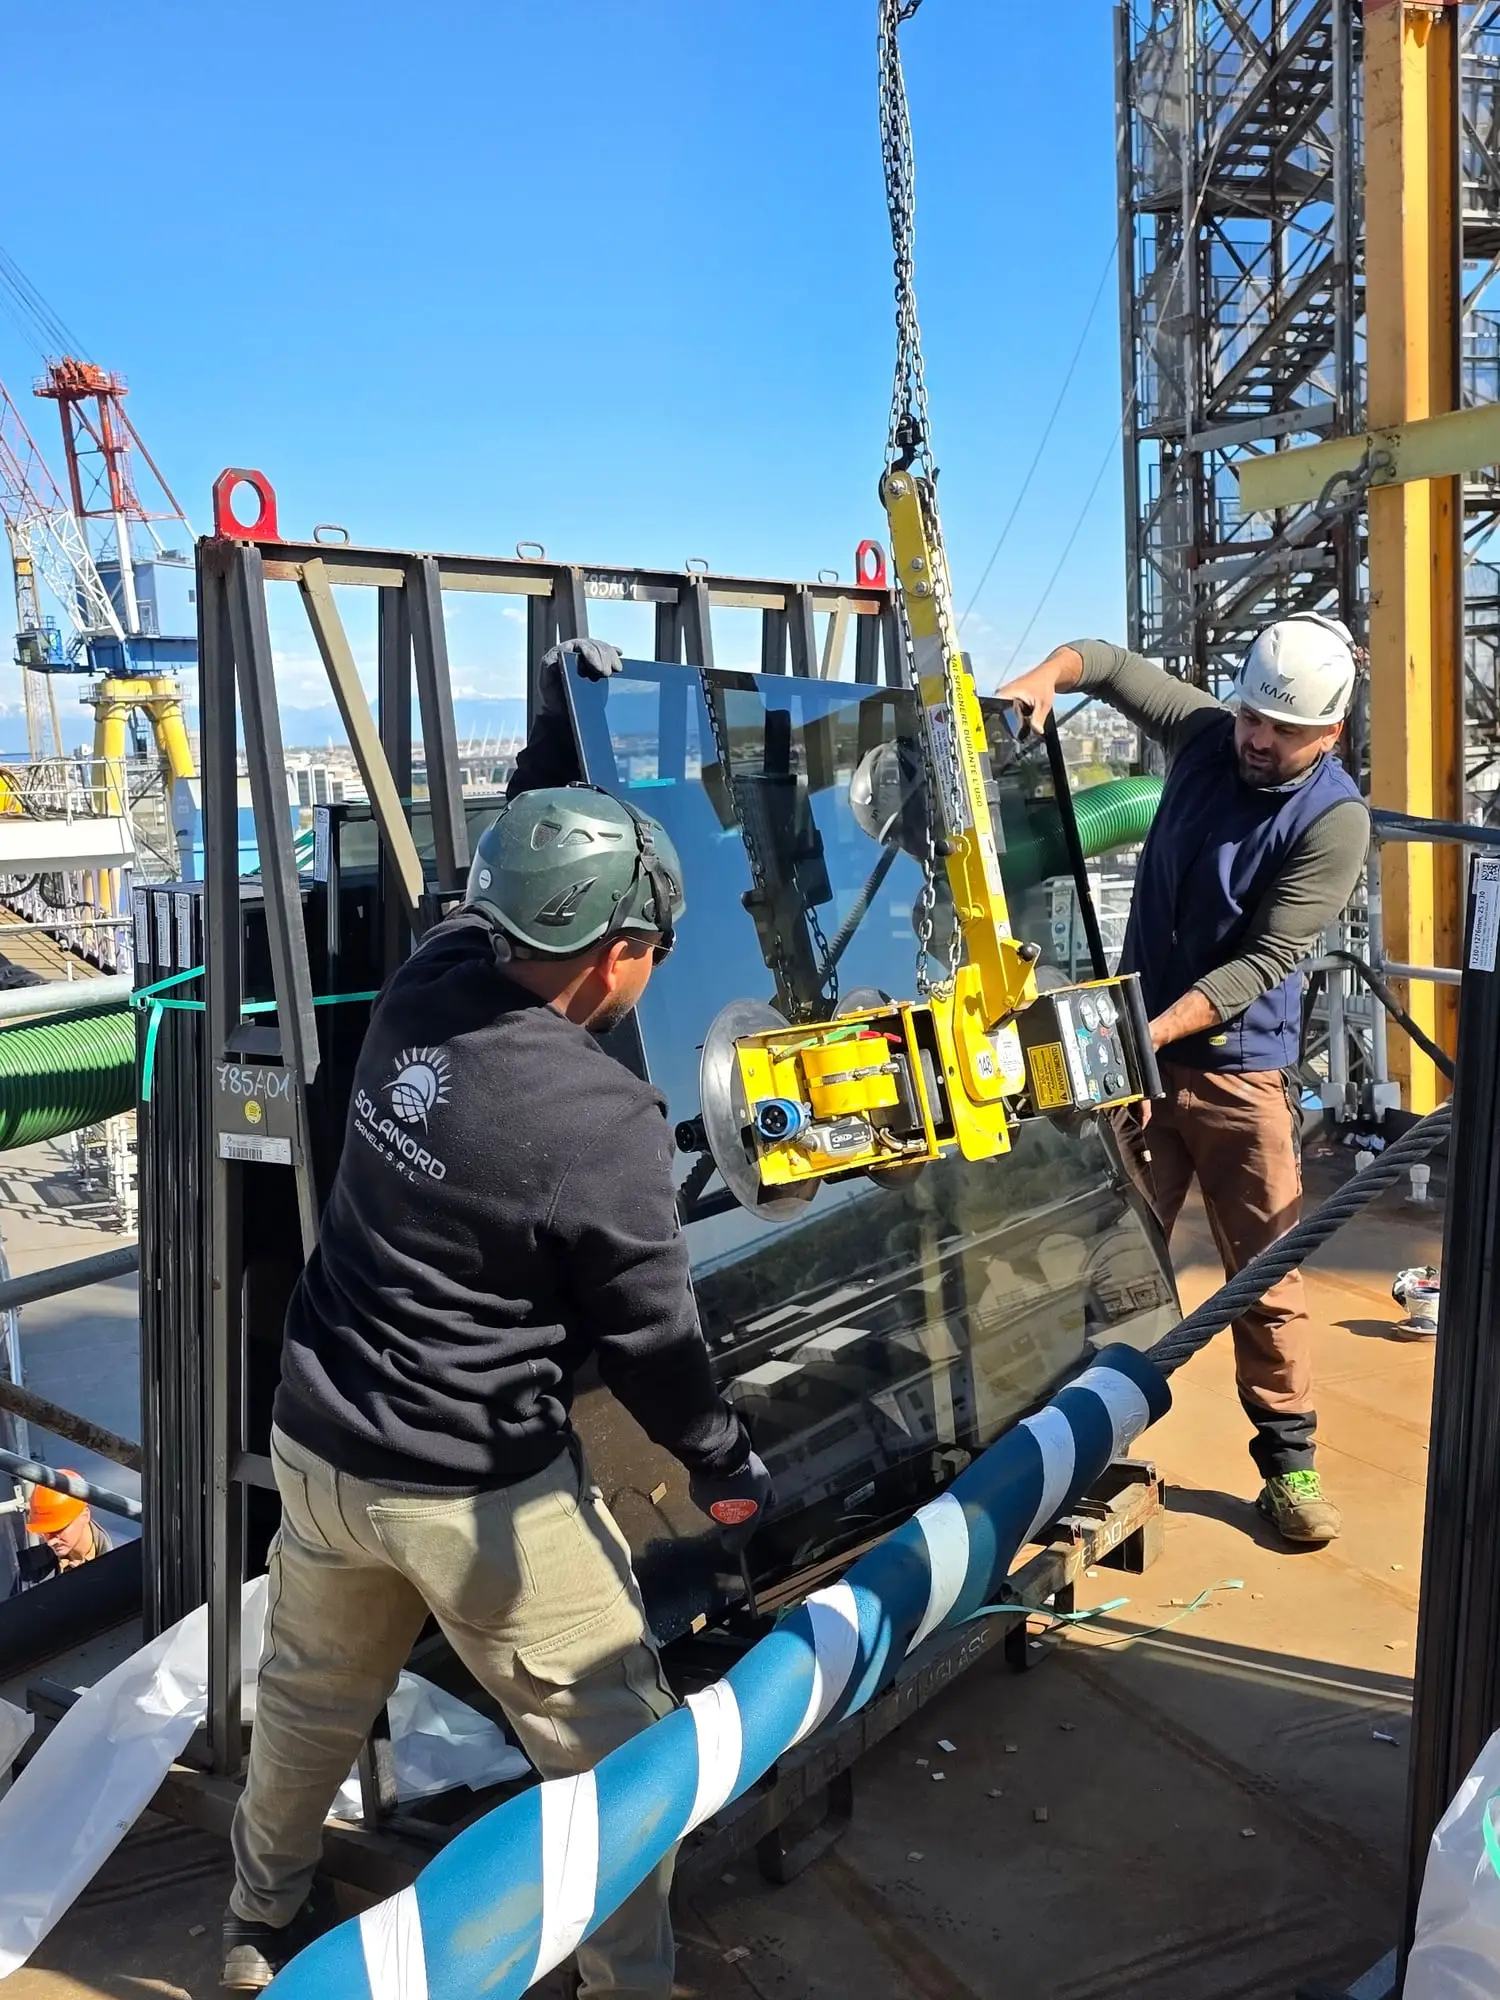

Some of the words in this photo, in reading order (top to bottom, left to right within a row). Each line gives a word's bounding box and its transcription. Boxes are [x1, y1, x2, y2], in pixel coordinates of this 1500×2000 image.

[1260, 681, 1297, 706] KASK
[953, 673, 969, 728] SPEGNERE
[963, 729, 978, 774] DURANTE
[216, 1063, 290, 1103] 785A01
[1051, 1047, 1065, 1090] AVVERTIMENTO
[353, 1118, 385, 1153] PANELS
[354, 1088, 447, 1181] SOLANORD
